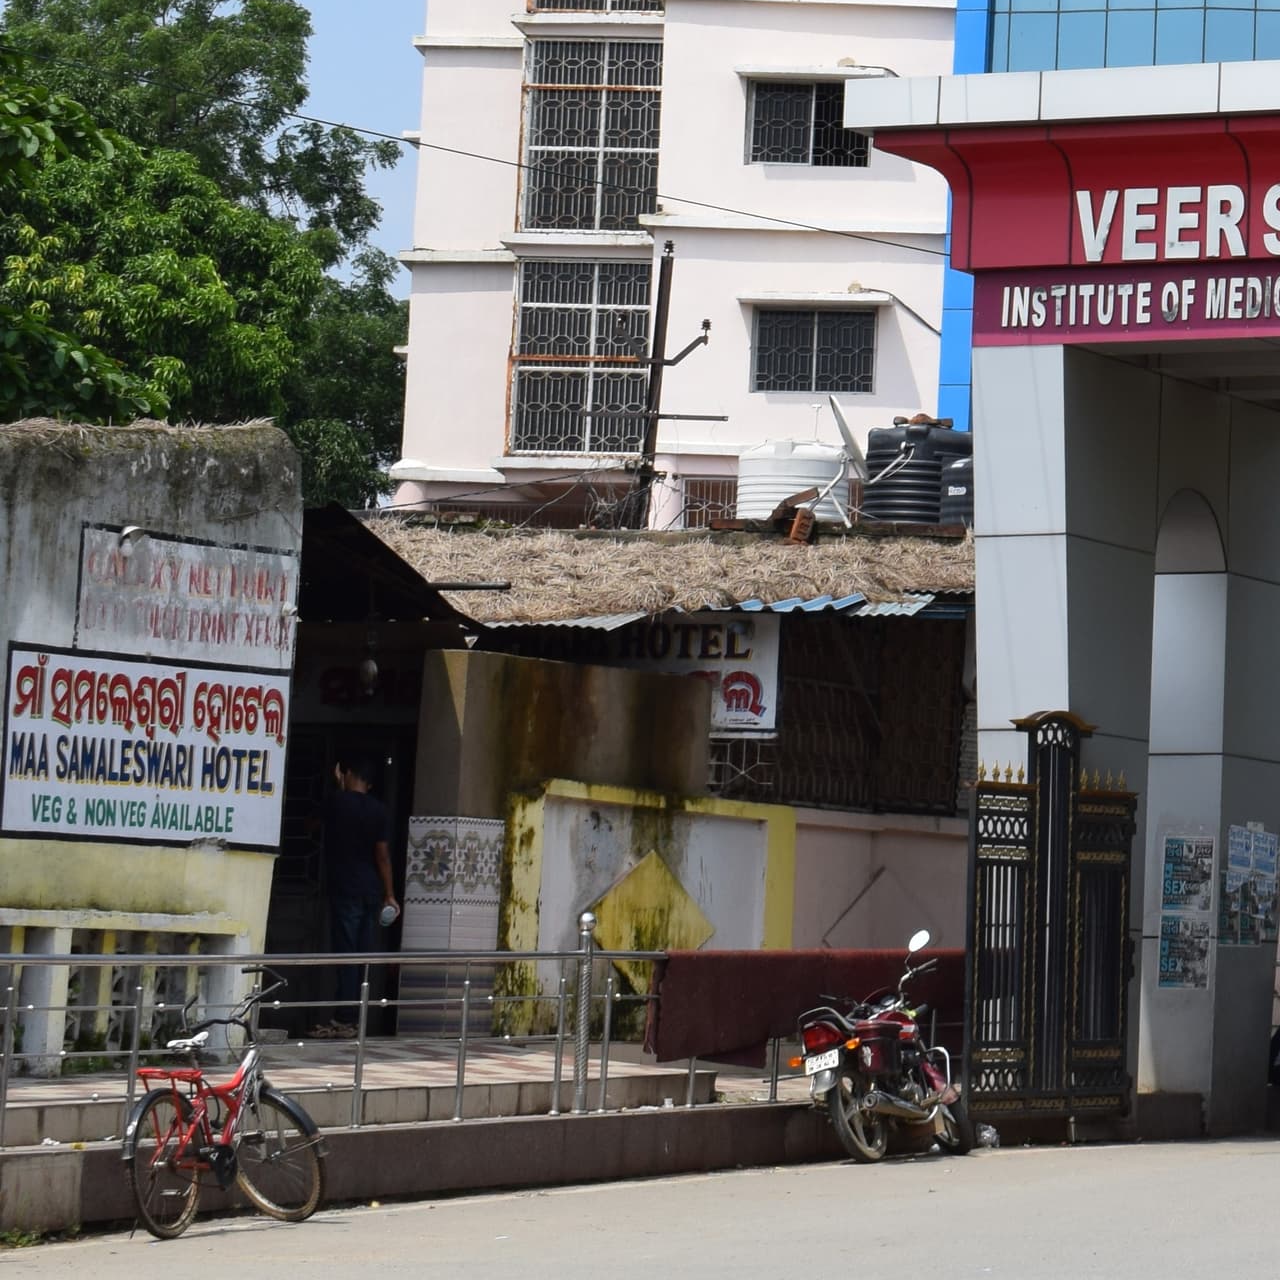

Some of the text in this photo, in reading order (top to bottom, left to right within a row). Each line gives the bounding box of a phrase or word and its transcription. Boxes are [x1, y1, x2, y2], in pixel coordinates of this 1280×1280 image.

[1075, 183, 1247, 263] VEER
[1001, 281, 1152, 328] INSTITUTE
[1160, 278, 1196, 323] OF
[618, 621, 753, 661] HOTEL
[13, 653, 49, 720] ମାଁ
[9, 731, 275, 796] MAA SAMALESWARI HOTEL
[31, 793, 234, 833] VEG & NON VEG AVAILABLE
[1164, 879, 1186, 895] SEX
[1160, 958, 1184, 972] SEX
